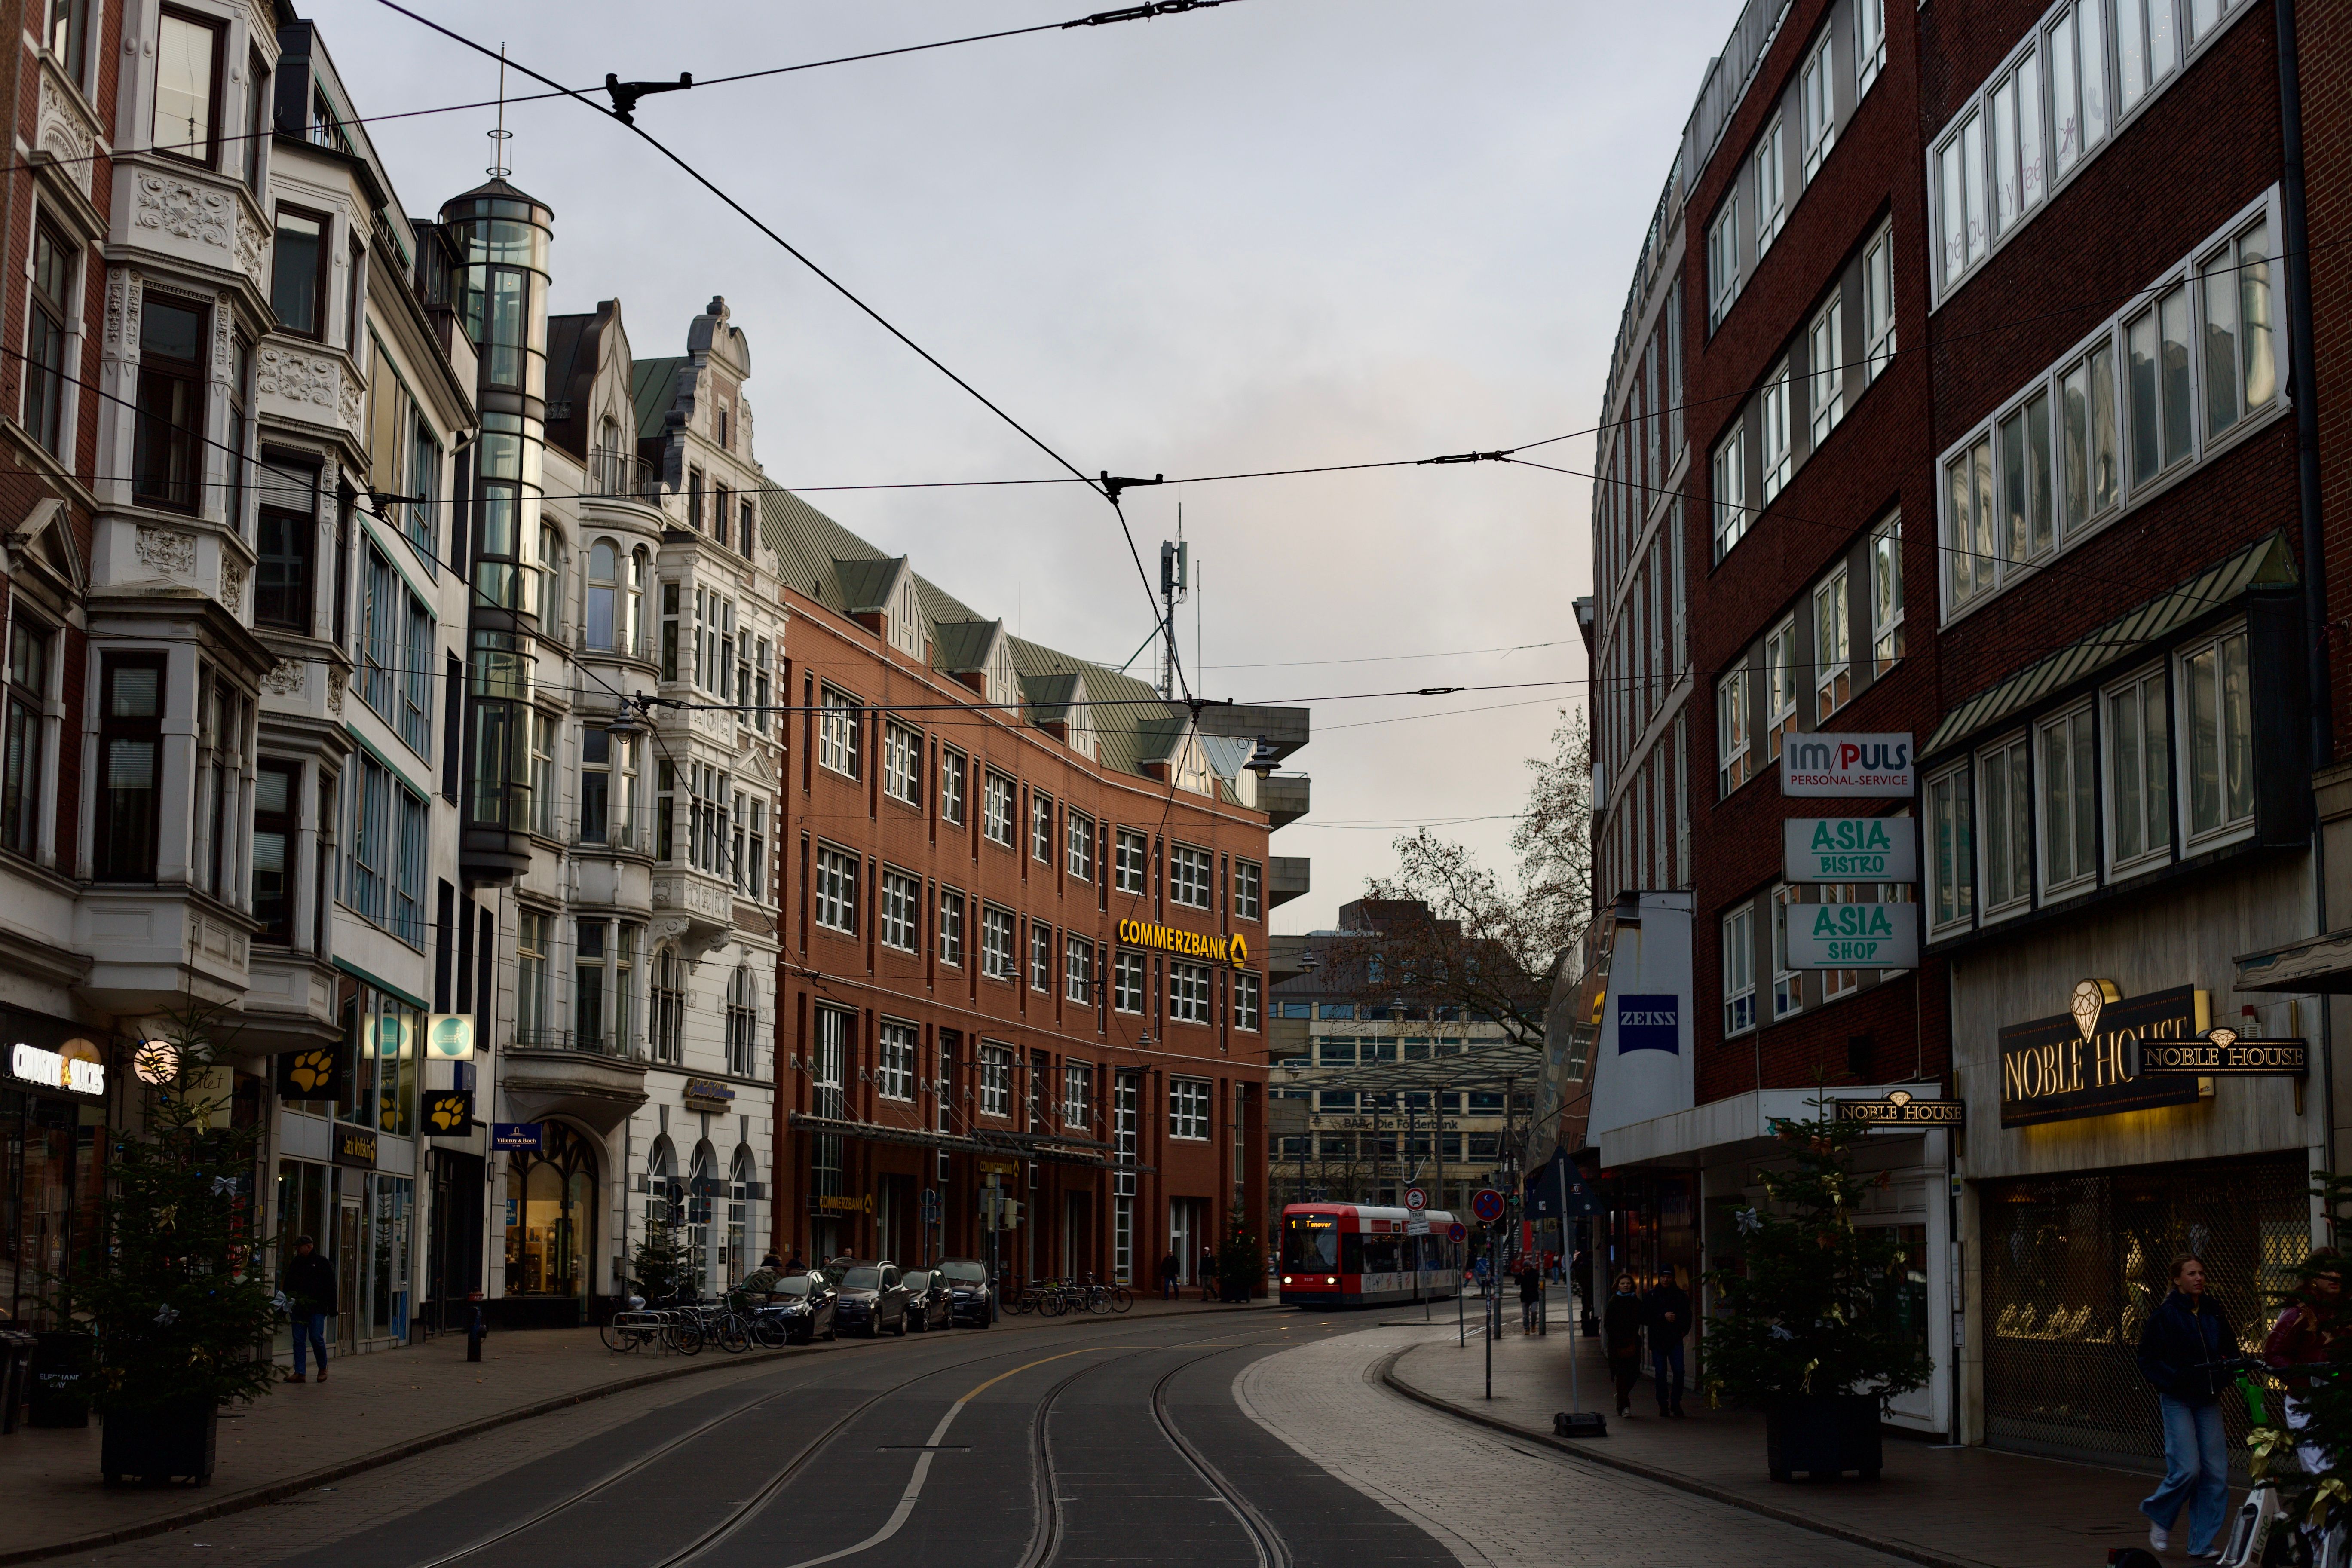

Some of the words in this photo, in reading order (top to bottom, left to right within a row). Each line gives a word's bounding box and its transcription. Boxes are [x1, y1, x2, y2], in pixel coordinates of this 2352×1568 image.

[1791, 775, 1908, 785] PERSONAL-SERVICE
[1811, 821, 1890, 850] ASIA
[1821, 855, 1884, 873] BISTRO
[1813, 906, 1892, 936] ASIA
[1118, 918, 1228, 961] COMMERZBANK
[1828, 942, 1877, 959] SHOP
[1620, 1011, 1676, 1026] ZEISS
[2144, 1048, 2219, 1066] NOBLE
[2228, 1047, 2304, 1066] HOUSE
[2003, 1038, 2084, 1102] NOBLE
[1839, 1106, 1897, 1120] NOBLE
[1903, 1106, 1962, 1120] HOUSE
[1378, 1119, 1393, 1129] Die
[1397, 1118, 1458, 1129] Föderbnk
[344, 1135, 354, 1155] Jack
[354, 1136, 370, 1158] Wolfskin
[820, 1195, 863, 1210] COMMERZBANK
[1291, 1220, 1296, 1228] 1
[1306, 1220, 1332, 1228] Tenever
[2253, 1515, 2270, 1553] Lime
